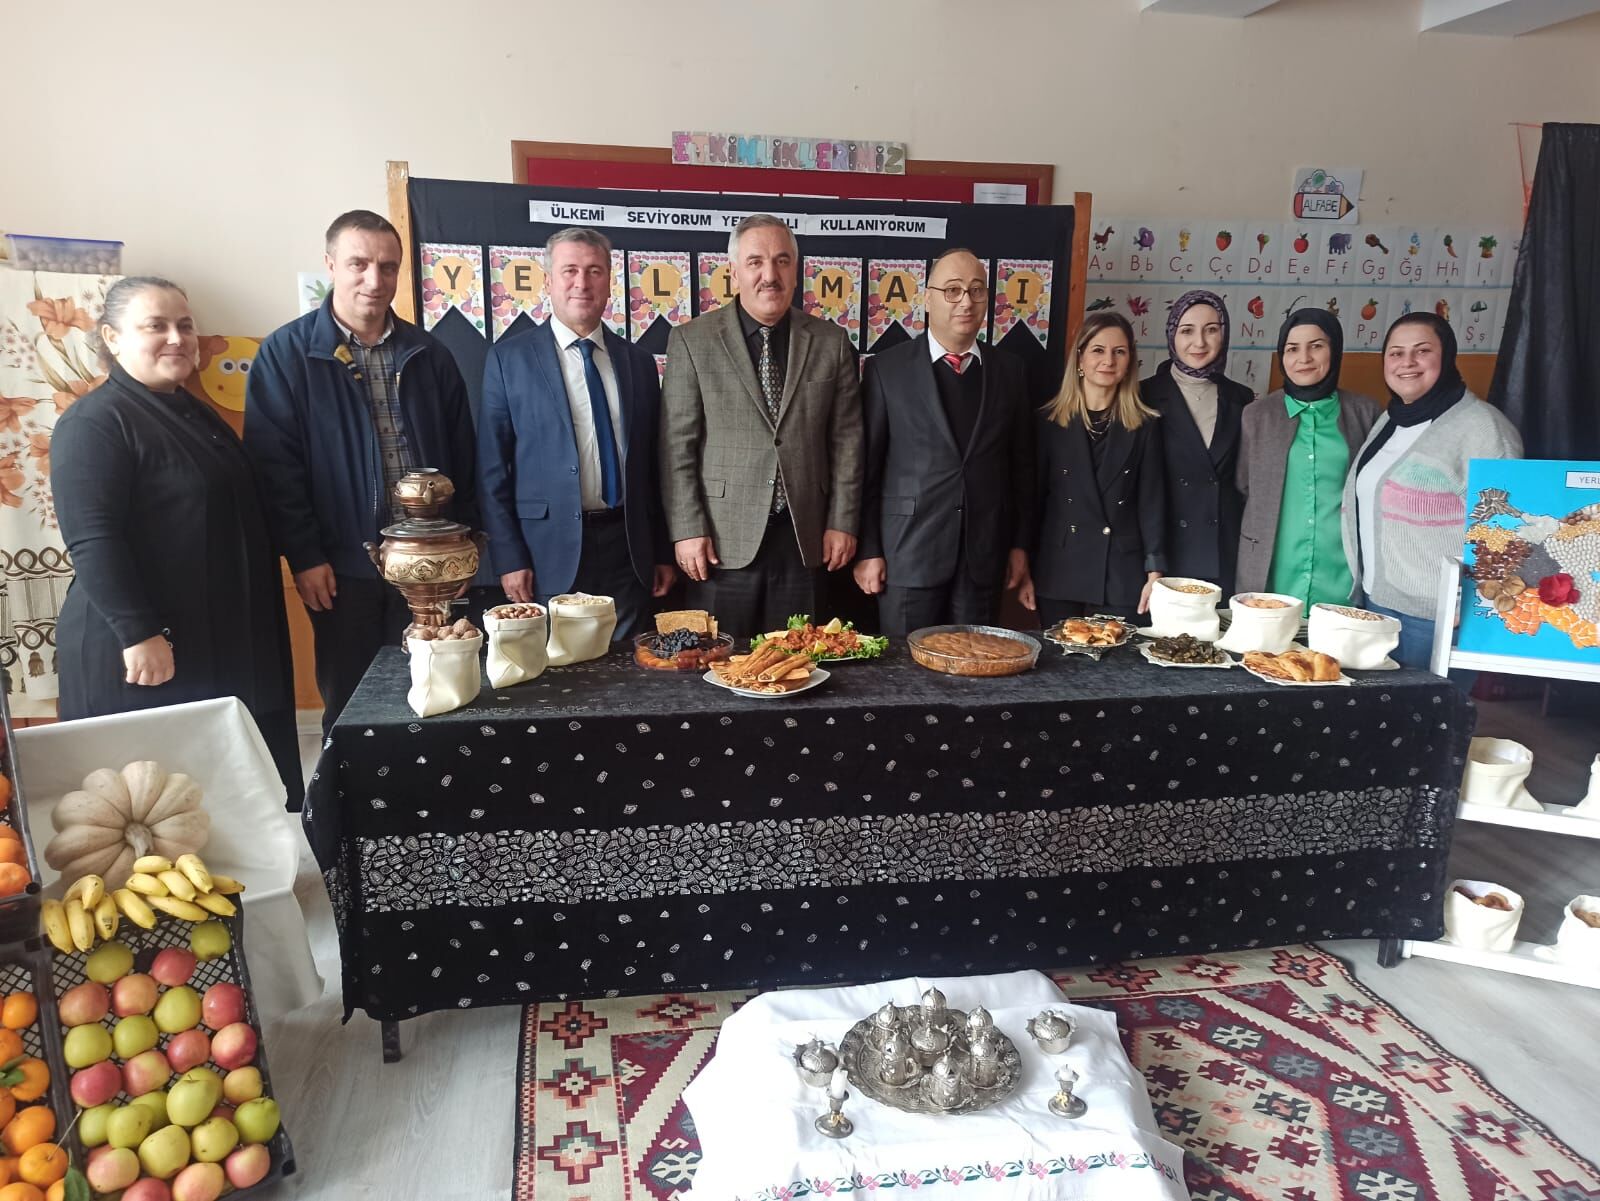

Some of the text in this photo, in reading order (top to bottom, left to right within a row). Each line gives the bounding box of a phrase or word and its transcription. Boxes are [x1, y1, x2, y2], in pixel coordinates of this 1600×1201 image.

[551, 203, 605, 222] ÜLKEMİ
[627, 209, 712, 226] SEVİYORUM
[820, 218, 926, 233] KULLANIYORUM
[1303, 199, 1338, 213] ALFABE
[442, 265, 463, 290] Y
[514, 265, 532, 292] E
[653, 268, 671, 297] L
[821, 275, 844, 299] M
[884, 275, 908, 303] A
[1016, 278, 1030, 304] I
